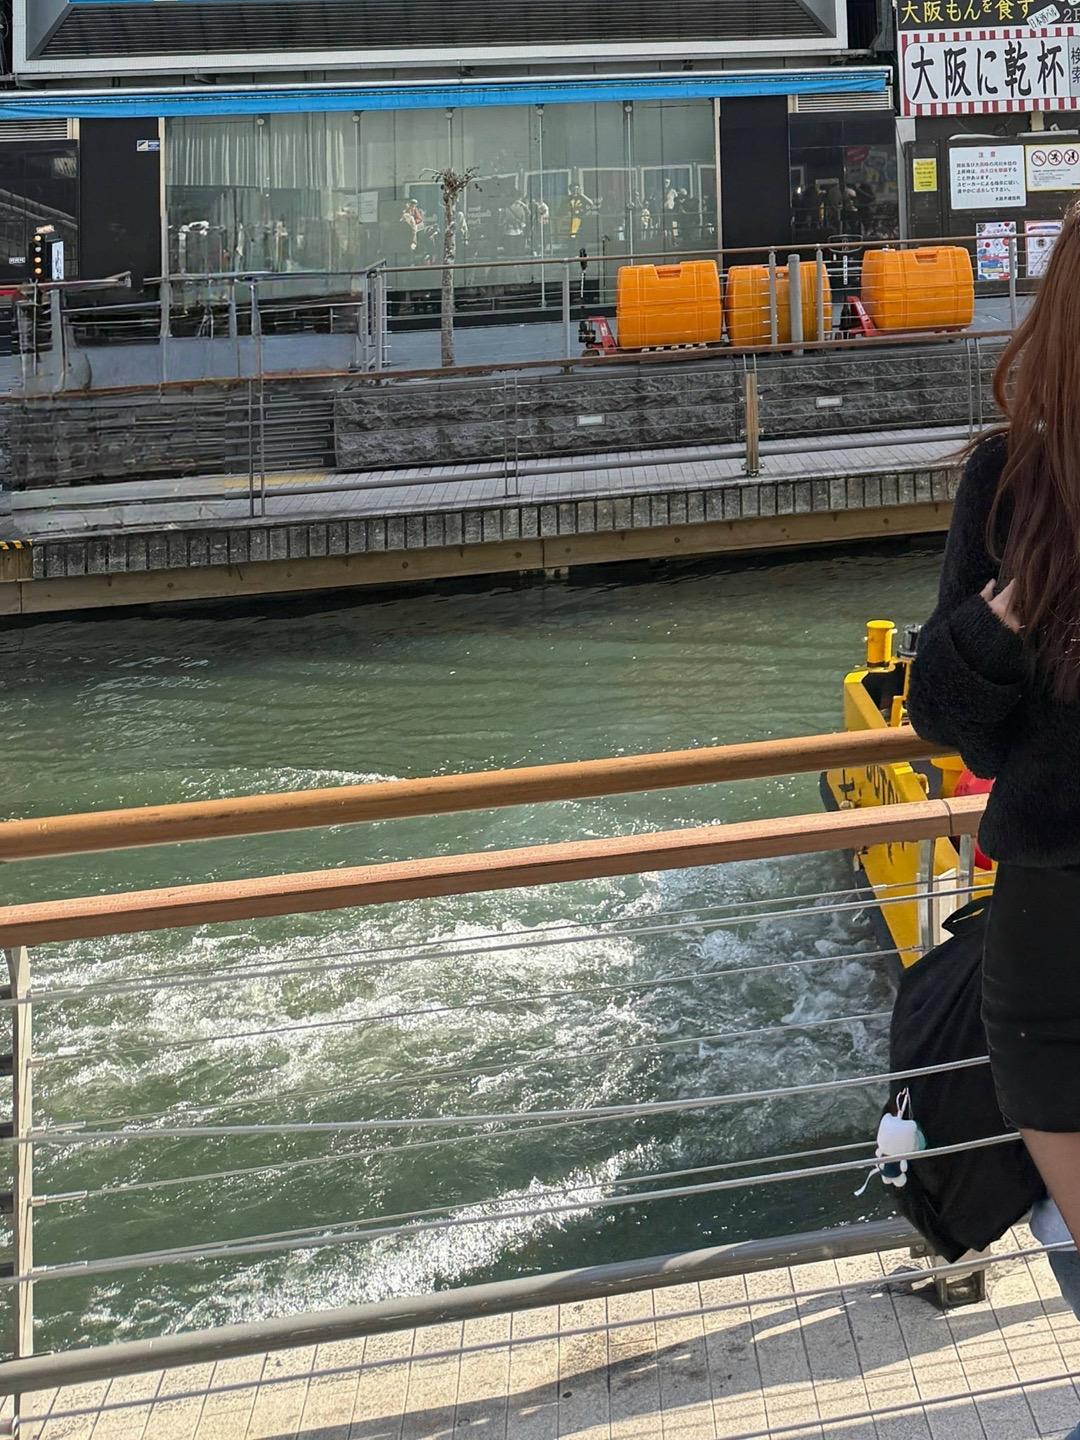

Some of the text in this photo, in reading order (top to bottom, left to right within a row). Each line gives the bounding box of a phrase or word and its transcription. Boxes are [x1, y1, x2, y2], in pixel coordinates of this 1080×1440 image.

[911, 40, 1065, 101] 大阪に乾杯
